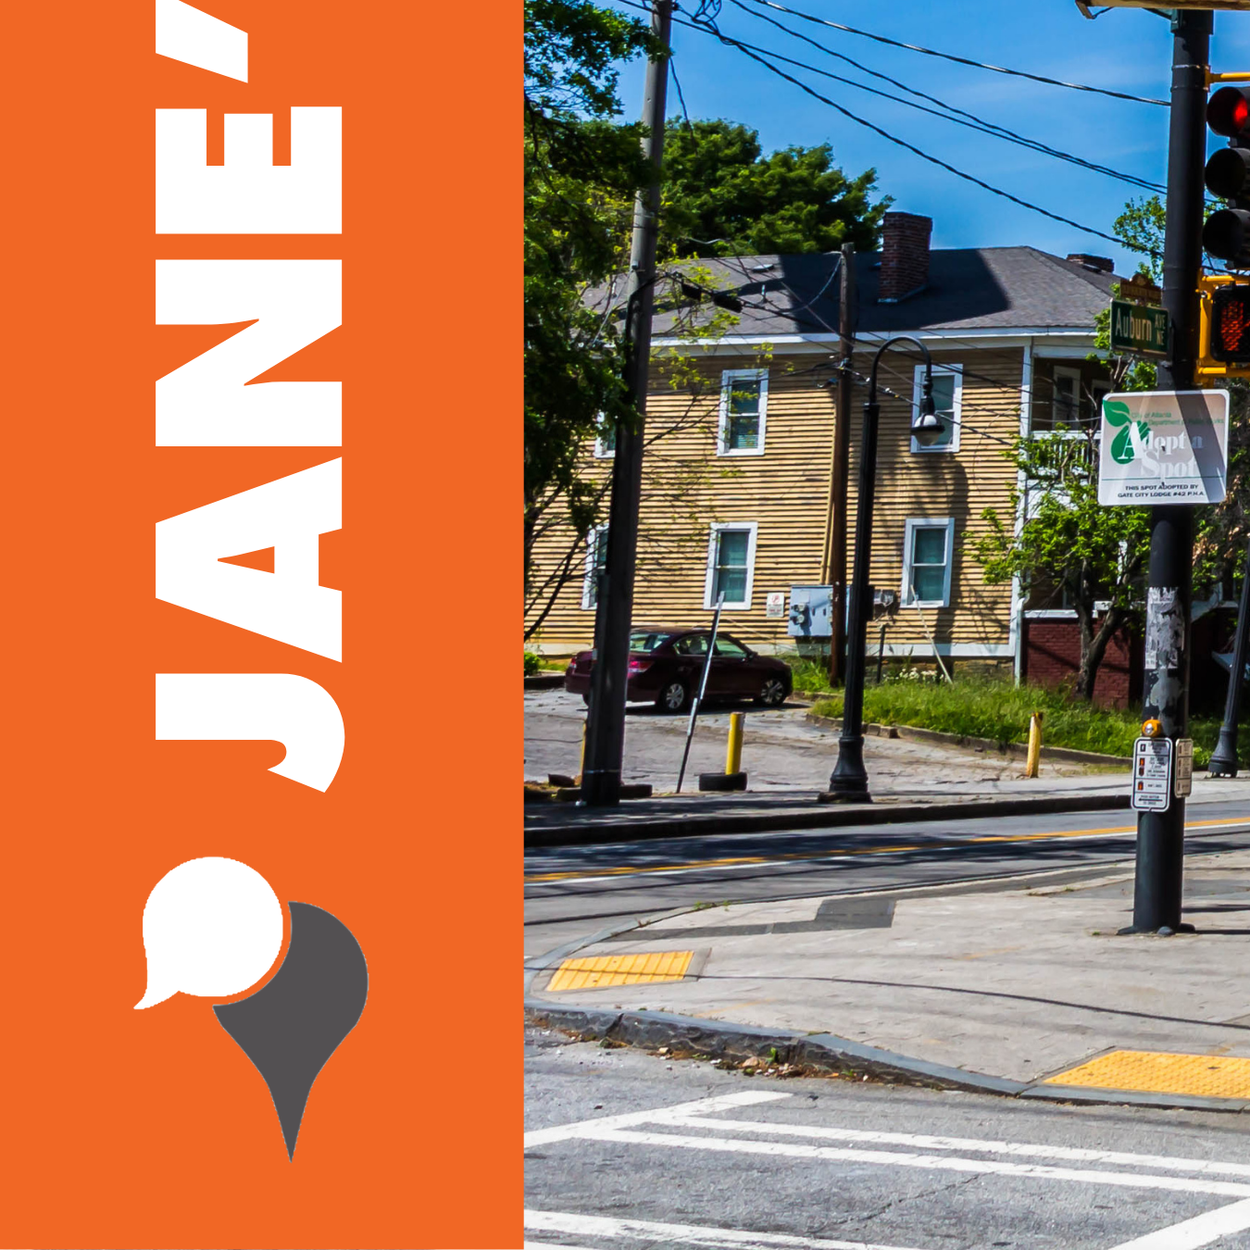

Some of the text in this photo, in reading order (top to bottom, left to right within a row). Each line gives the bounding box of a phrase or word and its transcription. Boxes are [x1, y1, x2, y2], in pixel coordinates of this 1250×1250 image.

[1115, 307, 1152, 342] Auburn
[1155, 314, 1166, 329] AVE
[1117, 421, 1204, 459] Adopt a
[1140, 450, 1197, 485] Spot
